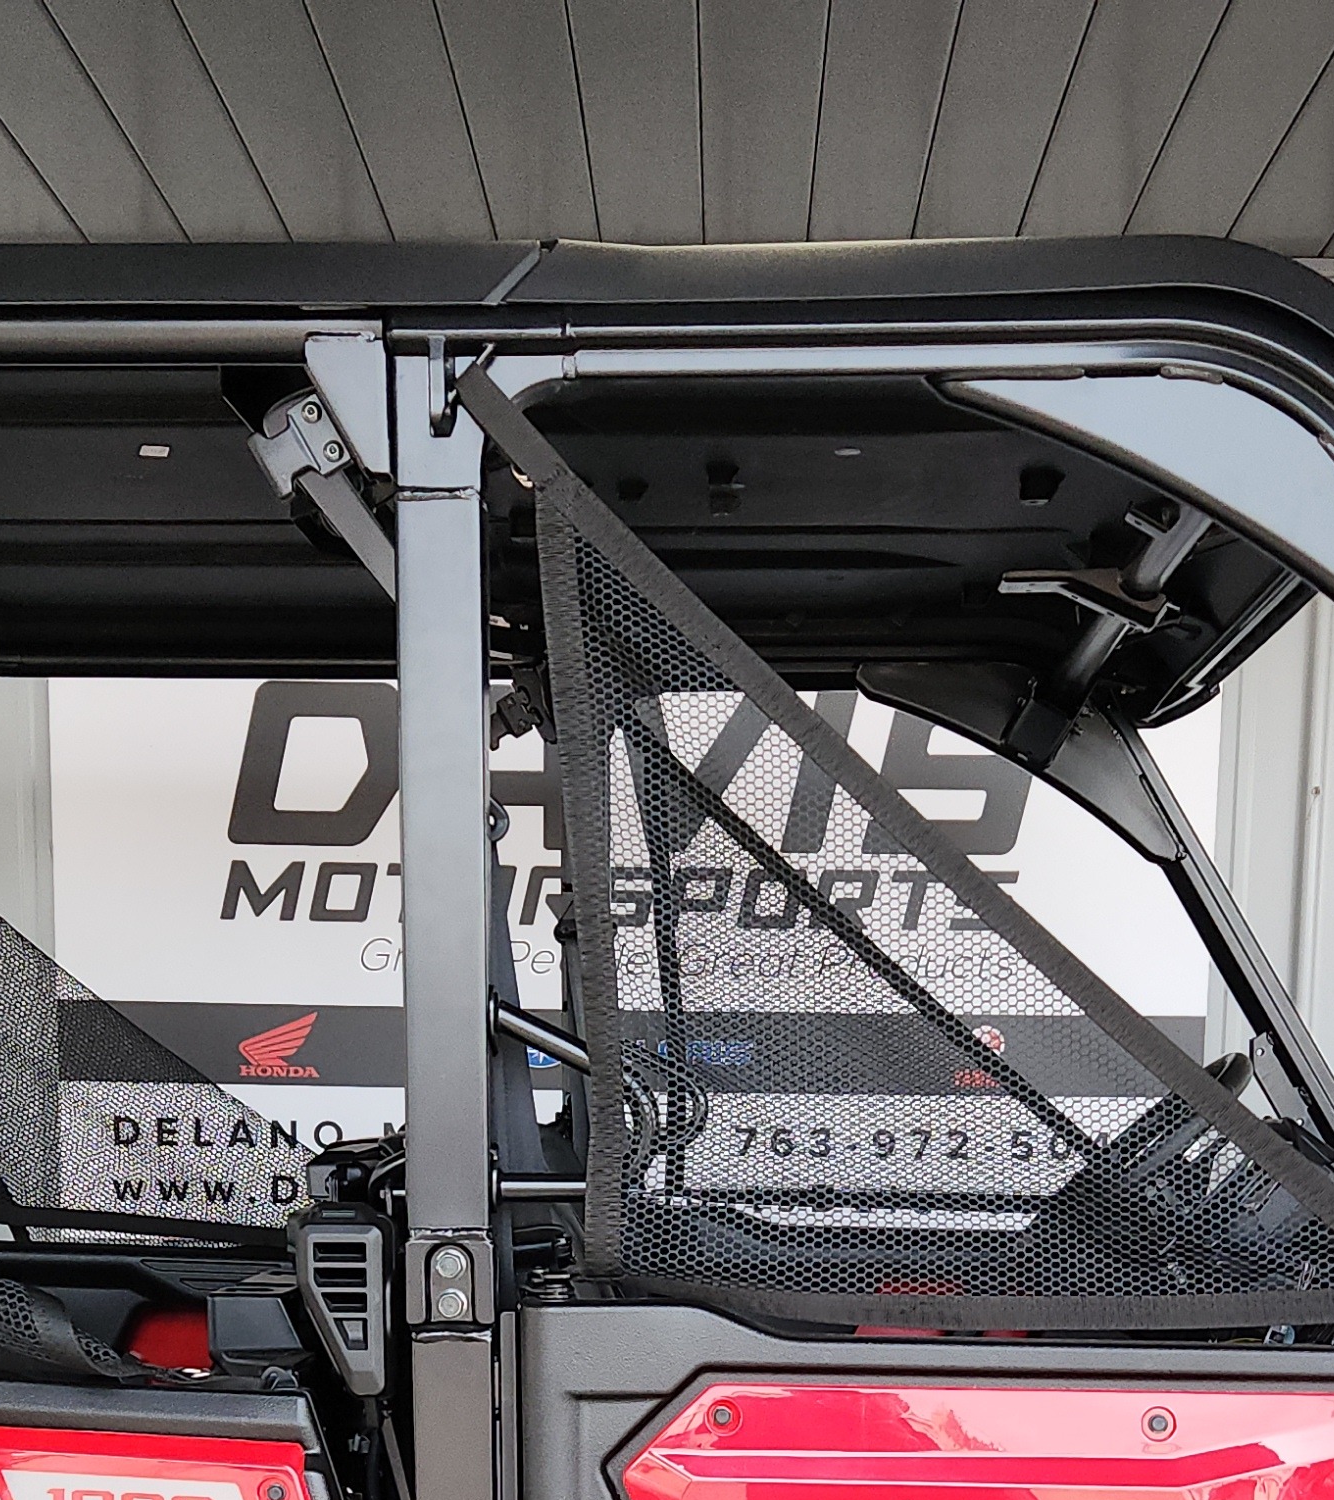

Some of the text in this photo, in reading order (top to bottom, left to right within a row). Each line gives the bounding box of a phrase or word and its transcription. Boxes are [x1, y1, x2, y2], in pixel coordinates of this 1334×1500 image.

[219, 859, 1021, 933] MORSPORT
[818, 945, 1016, 981] Prducts
[239, 1064, 320, 1079] HONDA
[107, 1116, 344, 1149] DELANO
